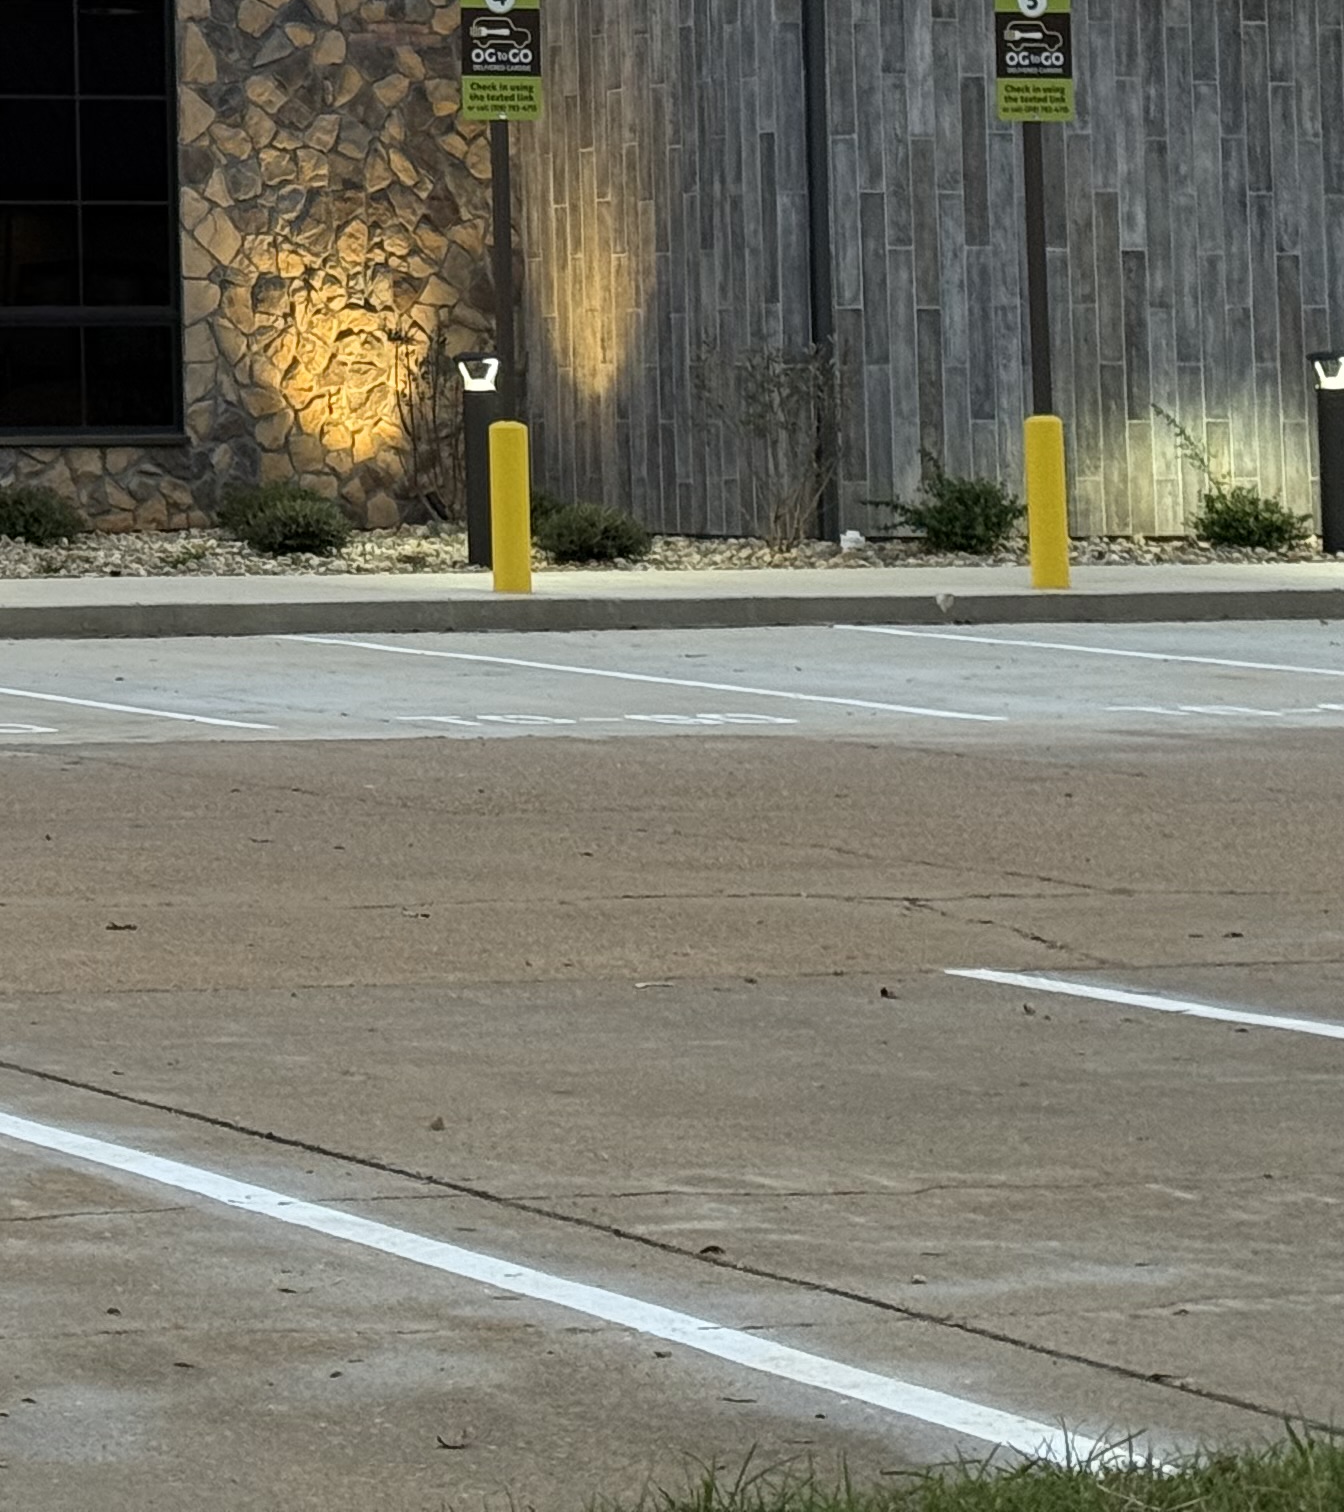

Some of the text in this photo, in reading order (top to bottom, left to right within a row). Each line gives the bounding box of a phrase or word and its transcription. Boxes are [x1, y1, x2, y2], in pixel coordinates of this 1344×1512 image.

[472, 48, 533, 63] OG to GO
[1006, 52, 1064, 66] OG to GO
[470, 81, 534, 93] Check in using
[469, 92, 534, 102] the texted link
